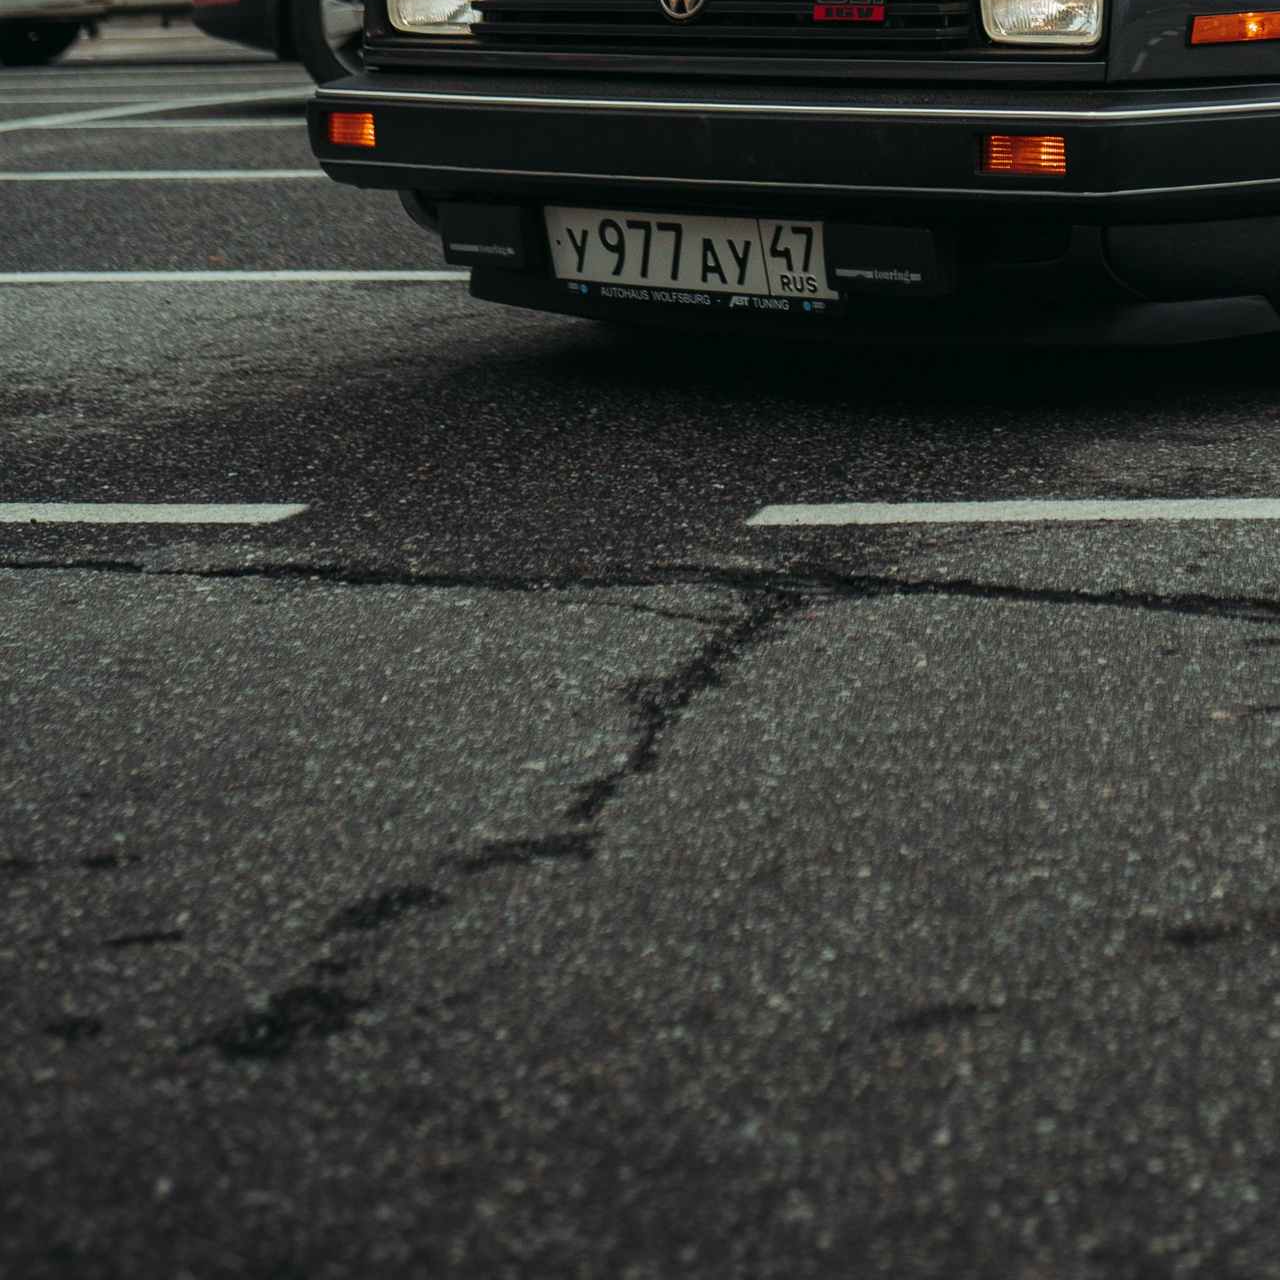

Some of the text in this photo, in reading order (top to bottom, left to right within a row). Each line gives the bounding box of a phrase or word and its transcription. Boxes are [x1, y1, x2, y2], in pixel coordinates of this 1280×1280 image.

[769, 225, 813, 272] 47
[780, 273, 818, 293] RUS
[873, 269, 910, 284] touring
[600, 286, 649, 301] AUTOHAUS
[651, 290, 711, 306] WOLFSBURG
[752, 297, 790, 311] TUNING
